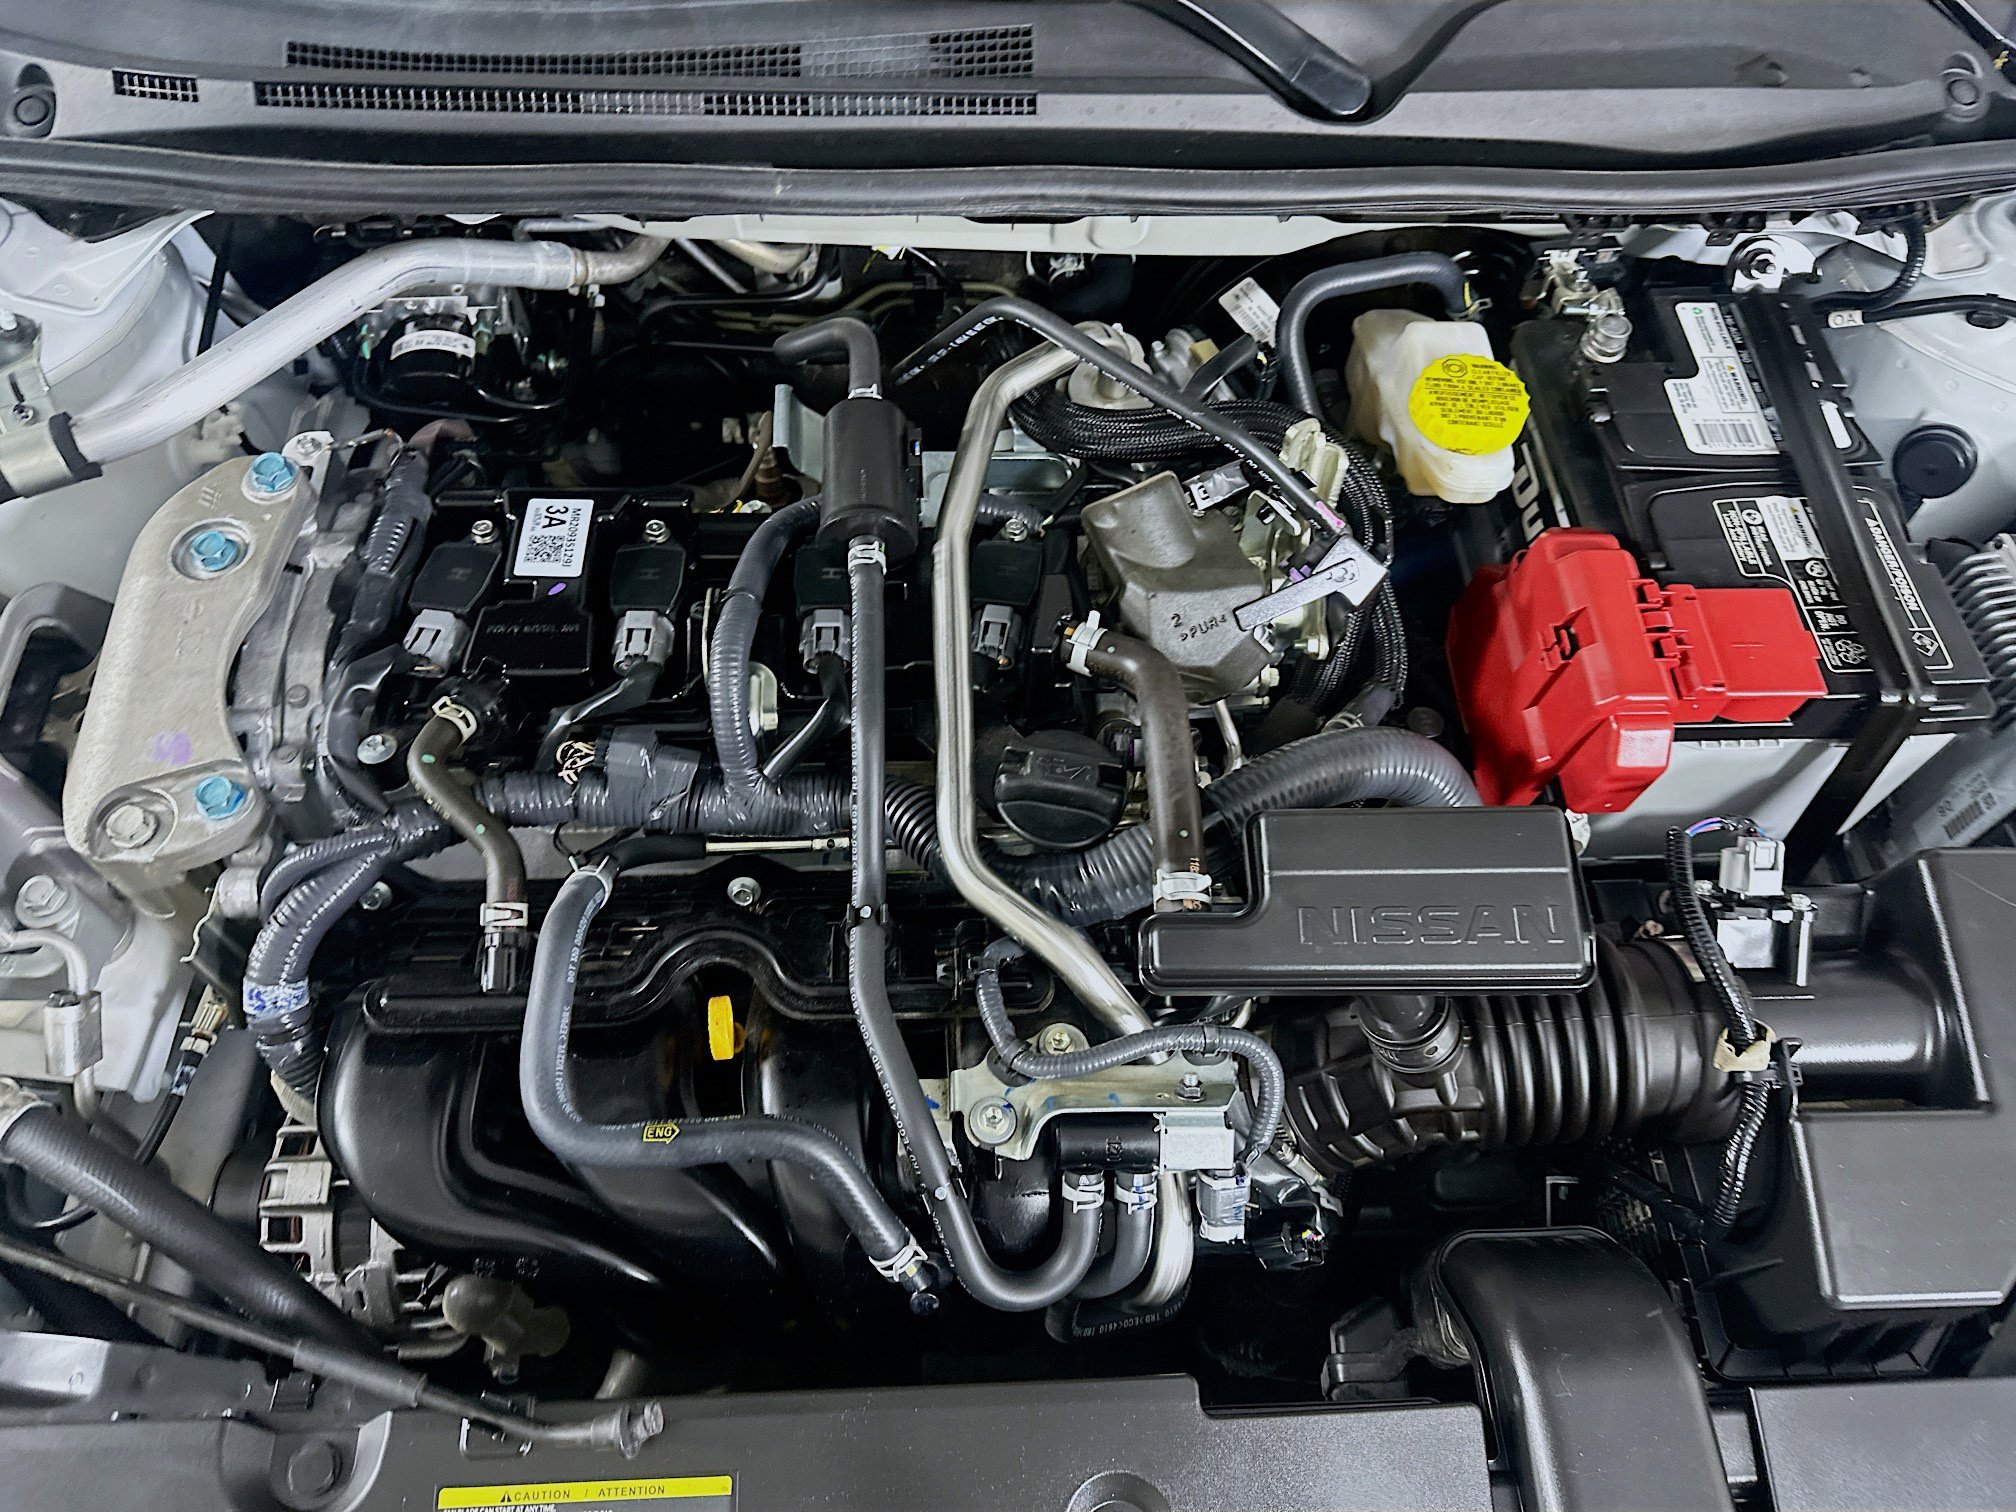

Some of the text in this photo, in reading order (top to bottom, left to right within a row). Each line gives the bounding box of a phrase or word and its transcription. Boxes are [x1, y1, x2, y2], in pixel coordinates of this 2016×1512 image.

[541, 505, 569, 529] 3A
[1299, 905, 1565, 945] NISSAN
[647, 1127, 674, 1138] ENG
[514, 1489, 571, 1501] CAUTION
[597, 1485, 666, 1497] ATTENTION
